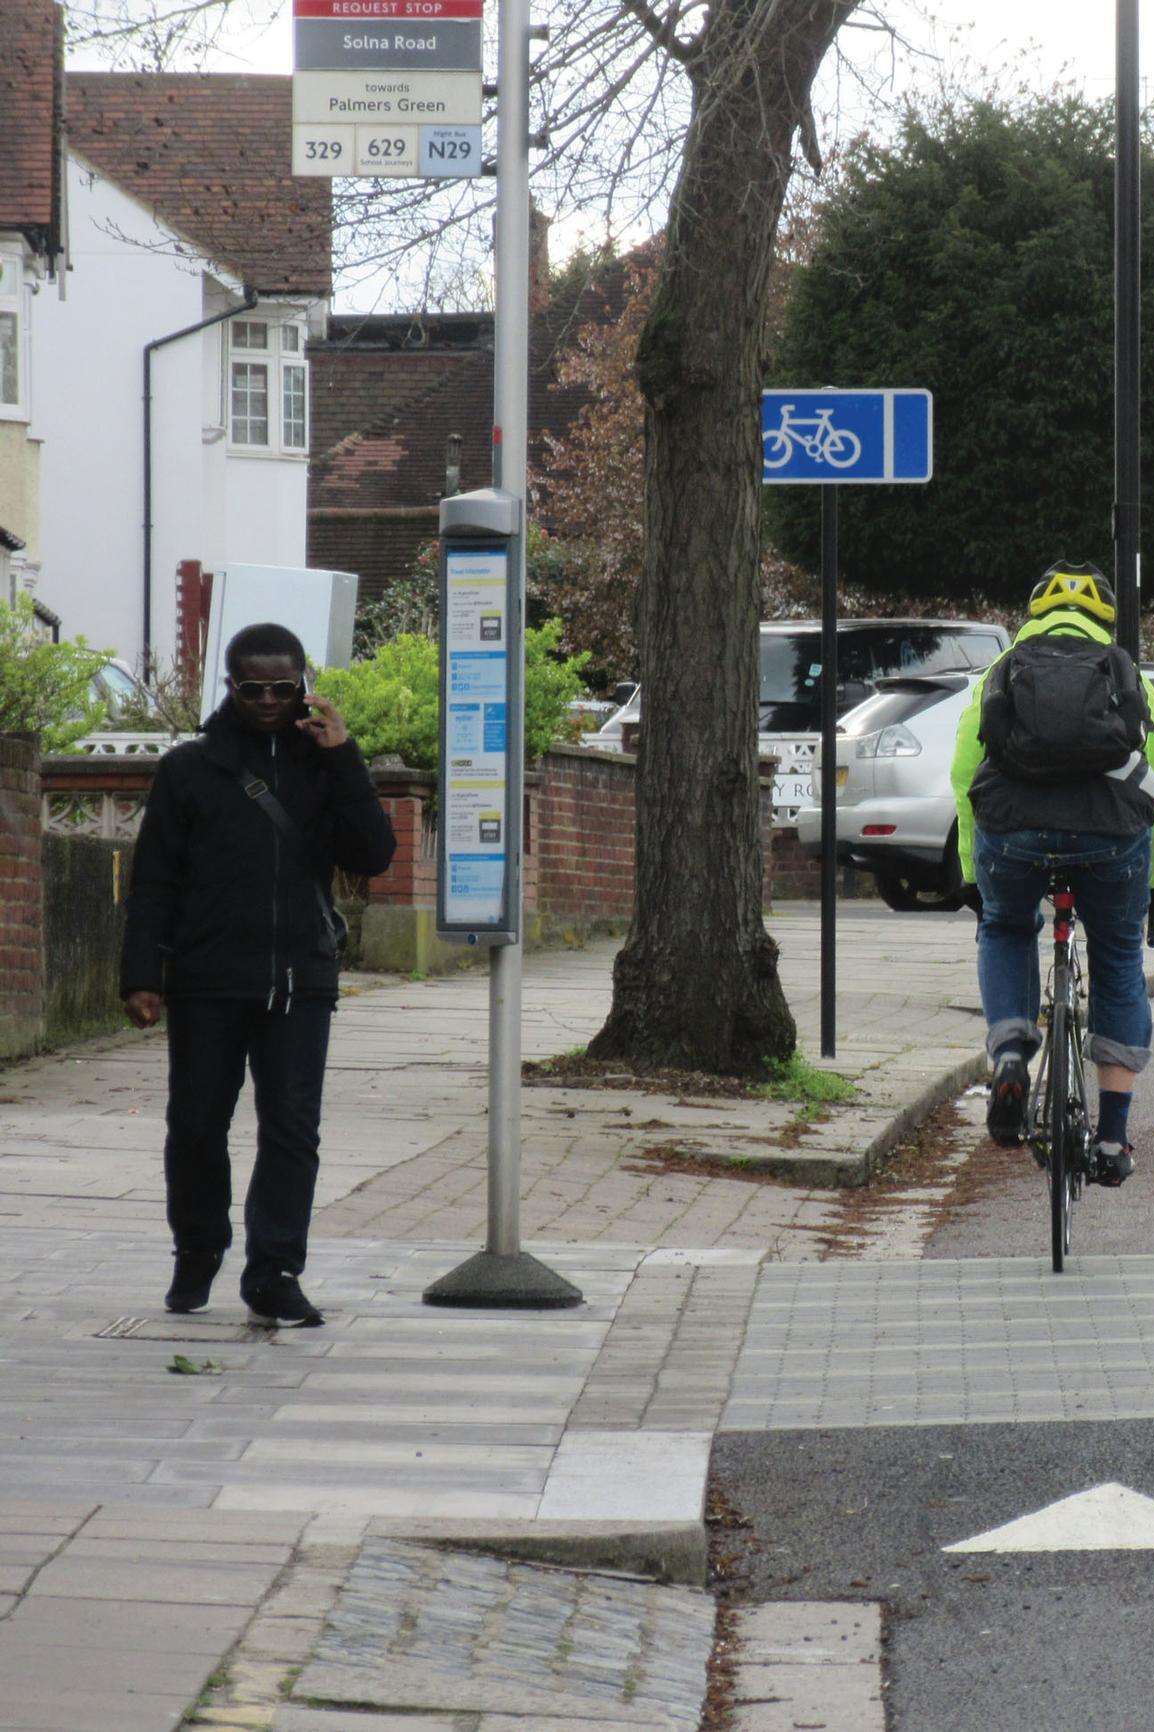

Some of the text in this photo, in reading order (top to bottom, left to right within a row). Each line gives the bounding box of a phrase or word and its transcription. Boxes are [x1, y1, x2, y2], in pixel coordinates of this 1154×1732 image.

[332, 2, 443, 14] REQUEST STOP
[343, 34, 436, 50] Solna Road
[365, 82, 410, 93] towards
[329, 97, 445, 112] Palmers Green
[305, 141, 343, 159] 329
[368, 138, 405, 157] 629
[428, 140, 471, 159] N29
[774, 783, 814, 797] Y RO
